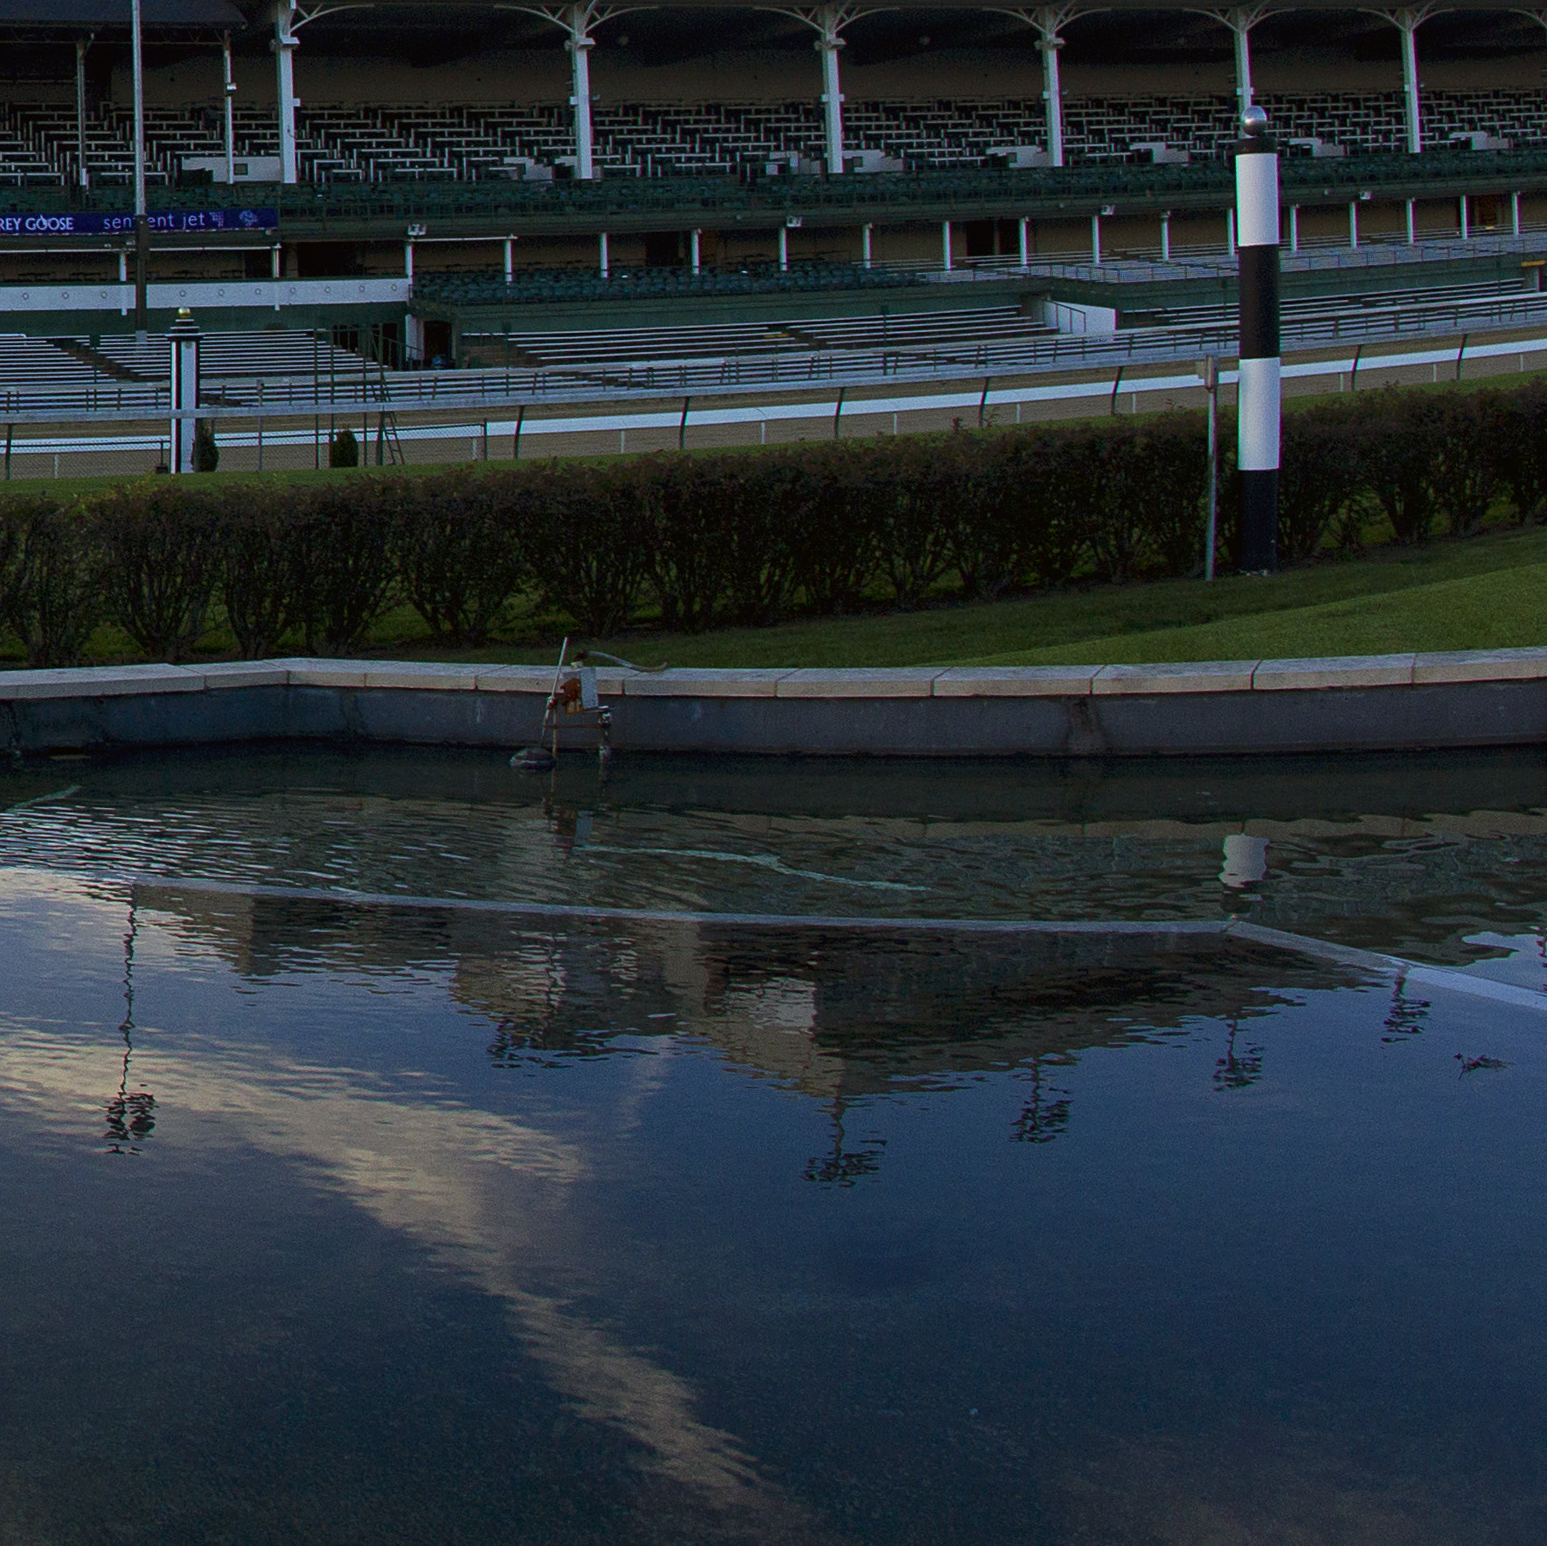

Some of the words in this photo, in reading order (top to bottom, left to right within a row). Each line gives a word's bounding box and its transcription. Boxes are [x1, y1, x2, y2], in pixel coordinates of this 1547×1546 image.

[24, 214, 75, 232] GOOSE
[103, 214, 175, 230] senent
[182, 212, 206, 230] jet
